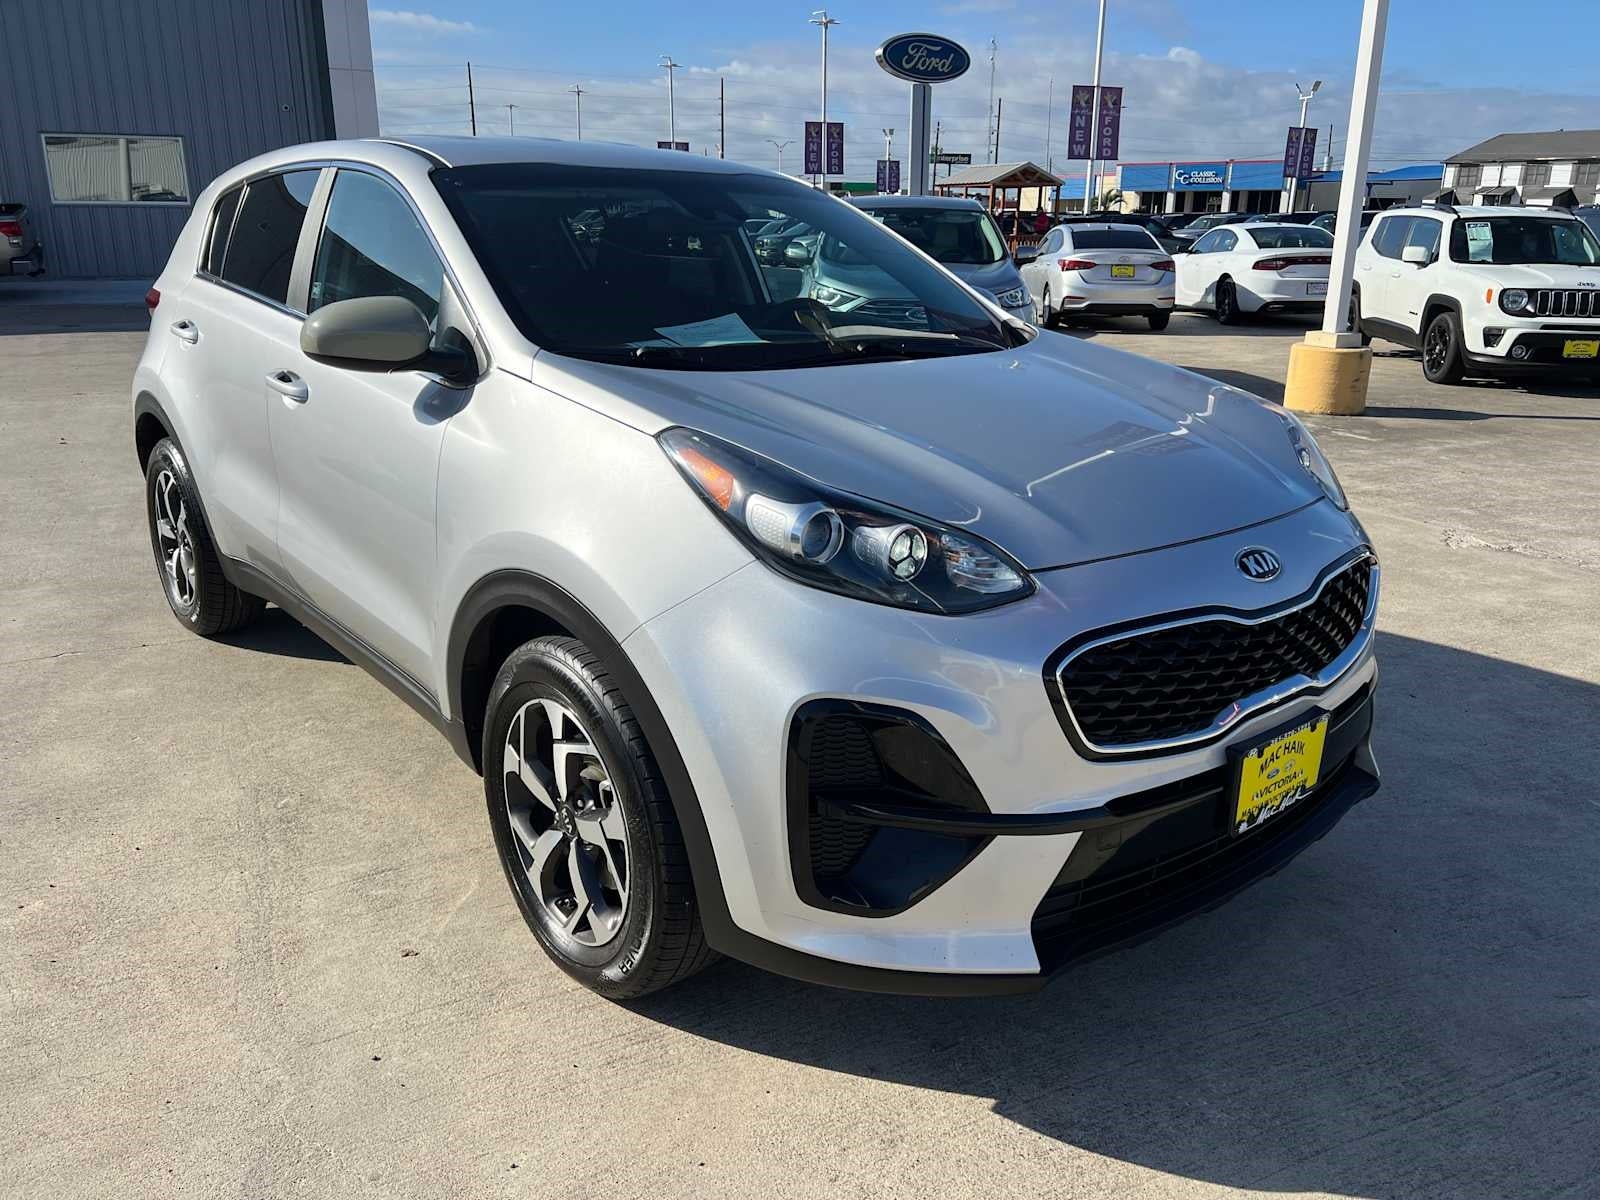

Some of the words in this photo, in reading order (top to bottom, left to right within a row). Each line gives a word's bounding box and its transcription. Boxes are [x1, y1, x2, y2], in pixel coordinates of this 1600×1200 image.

[902, 42, 954, 72] Ford
[1072, 115, 1086, 156] NEW
[1102, 116, 1113, 156] FORD
[808, 143, 819, 171] NEW
[831, 143, 840, 172] FORD
[1190, 170, 1217, 178] CLASSIC
[1240, 552, 1279, 576] KIA
[1258, 745, 1282, 778] MAC
[1282, 740, 1305, 756] HAIK
